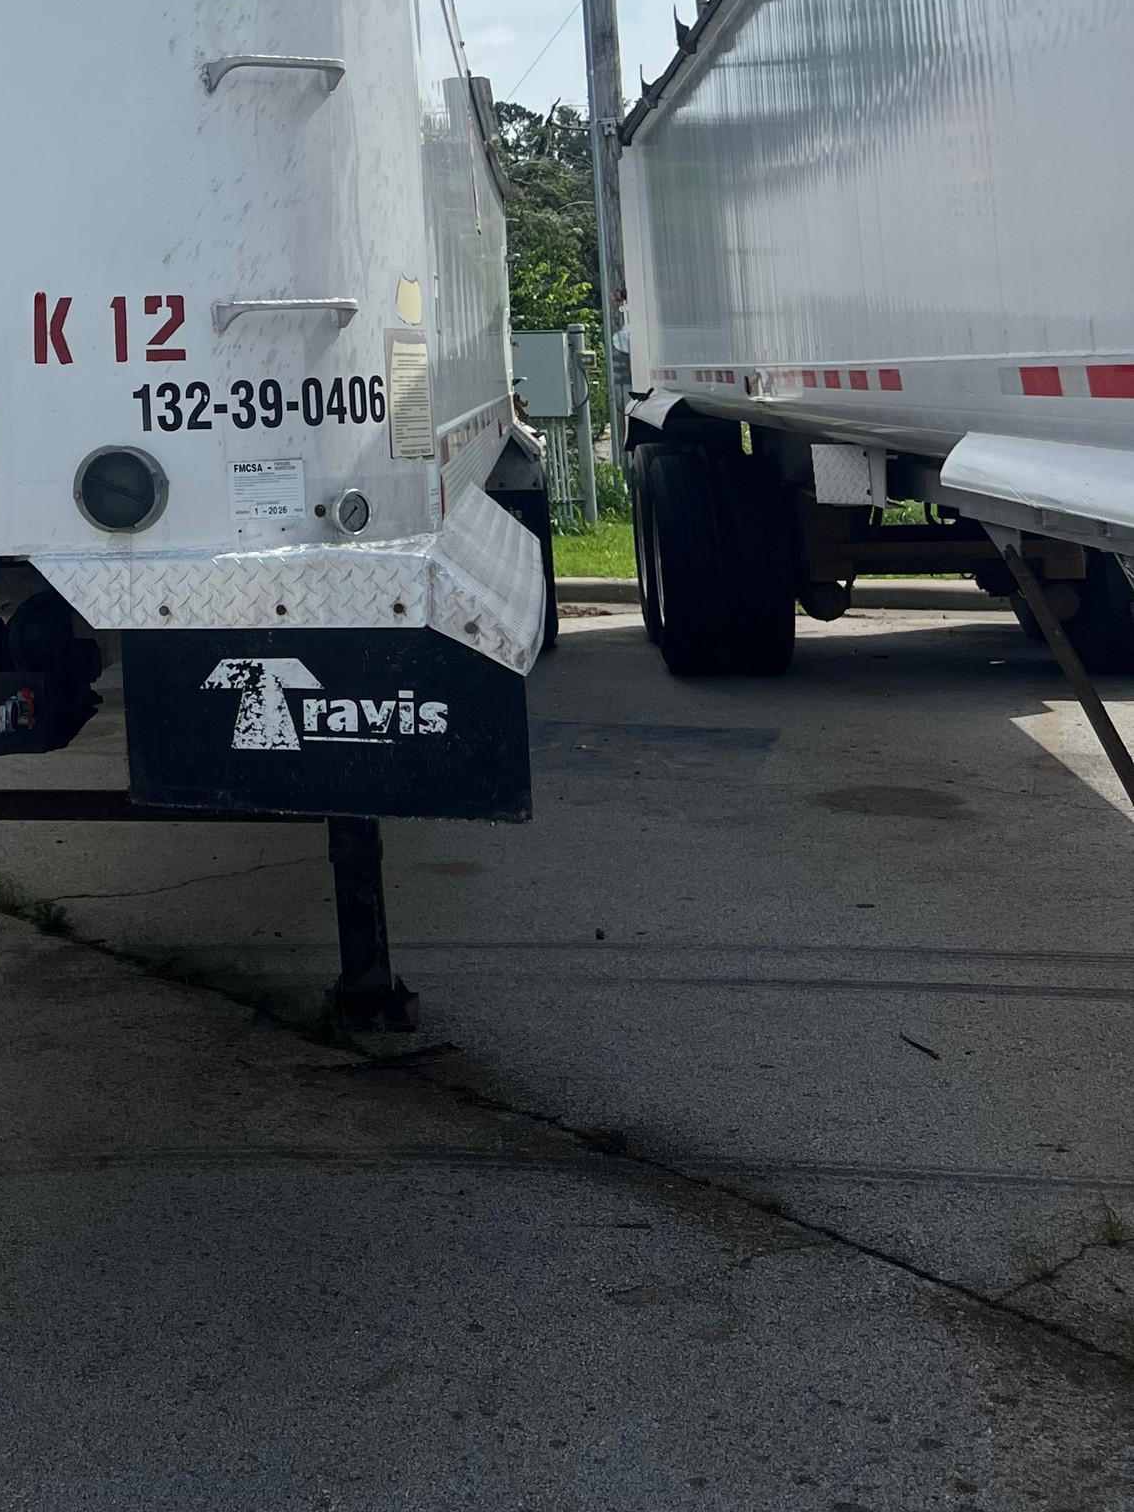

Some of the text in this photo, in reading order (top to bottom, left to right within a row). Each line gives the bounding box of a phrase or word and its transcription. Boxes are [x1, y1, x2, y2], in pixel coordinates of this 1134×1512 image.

[35, 293, 187, 364] K 12
[132, 375, 386, 432] 132-39-0406
[234, 464, 263, 472] FMCSA
[200, 657, 449, 751] Travis
